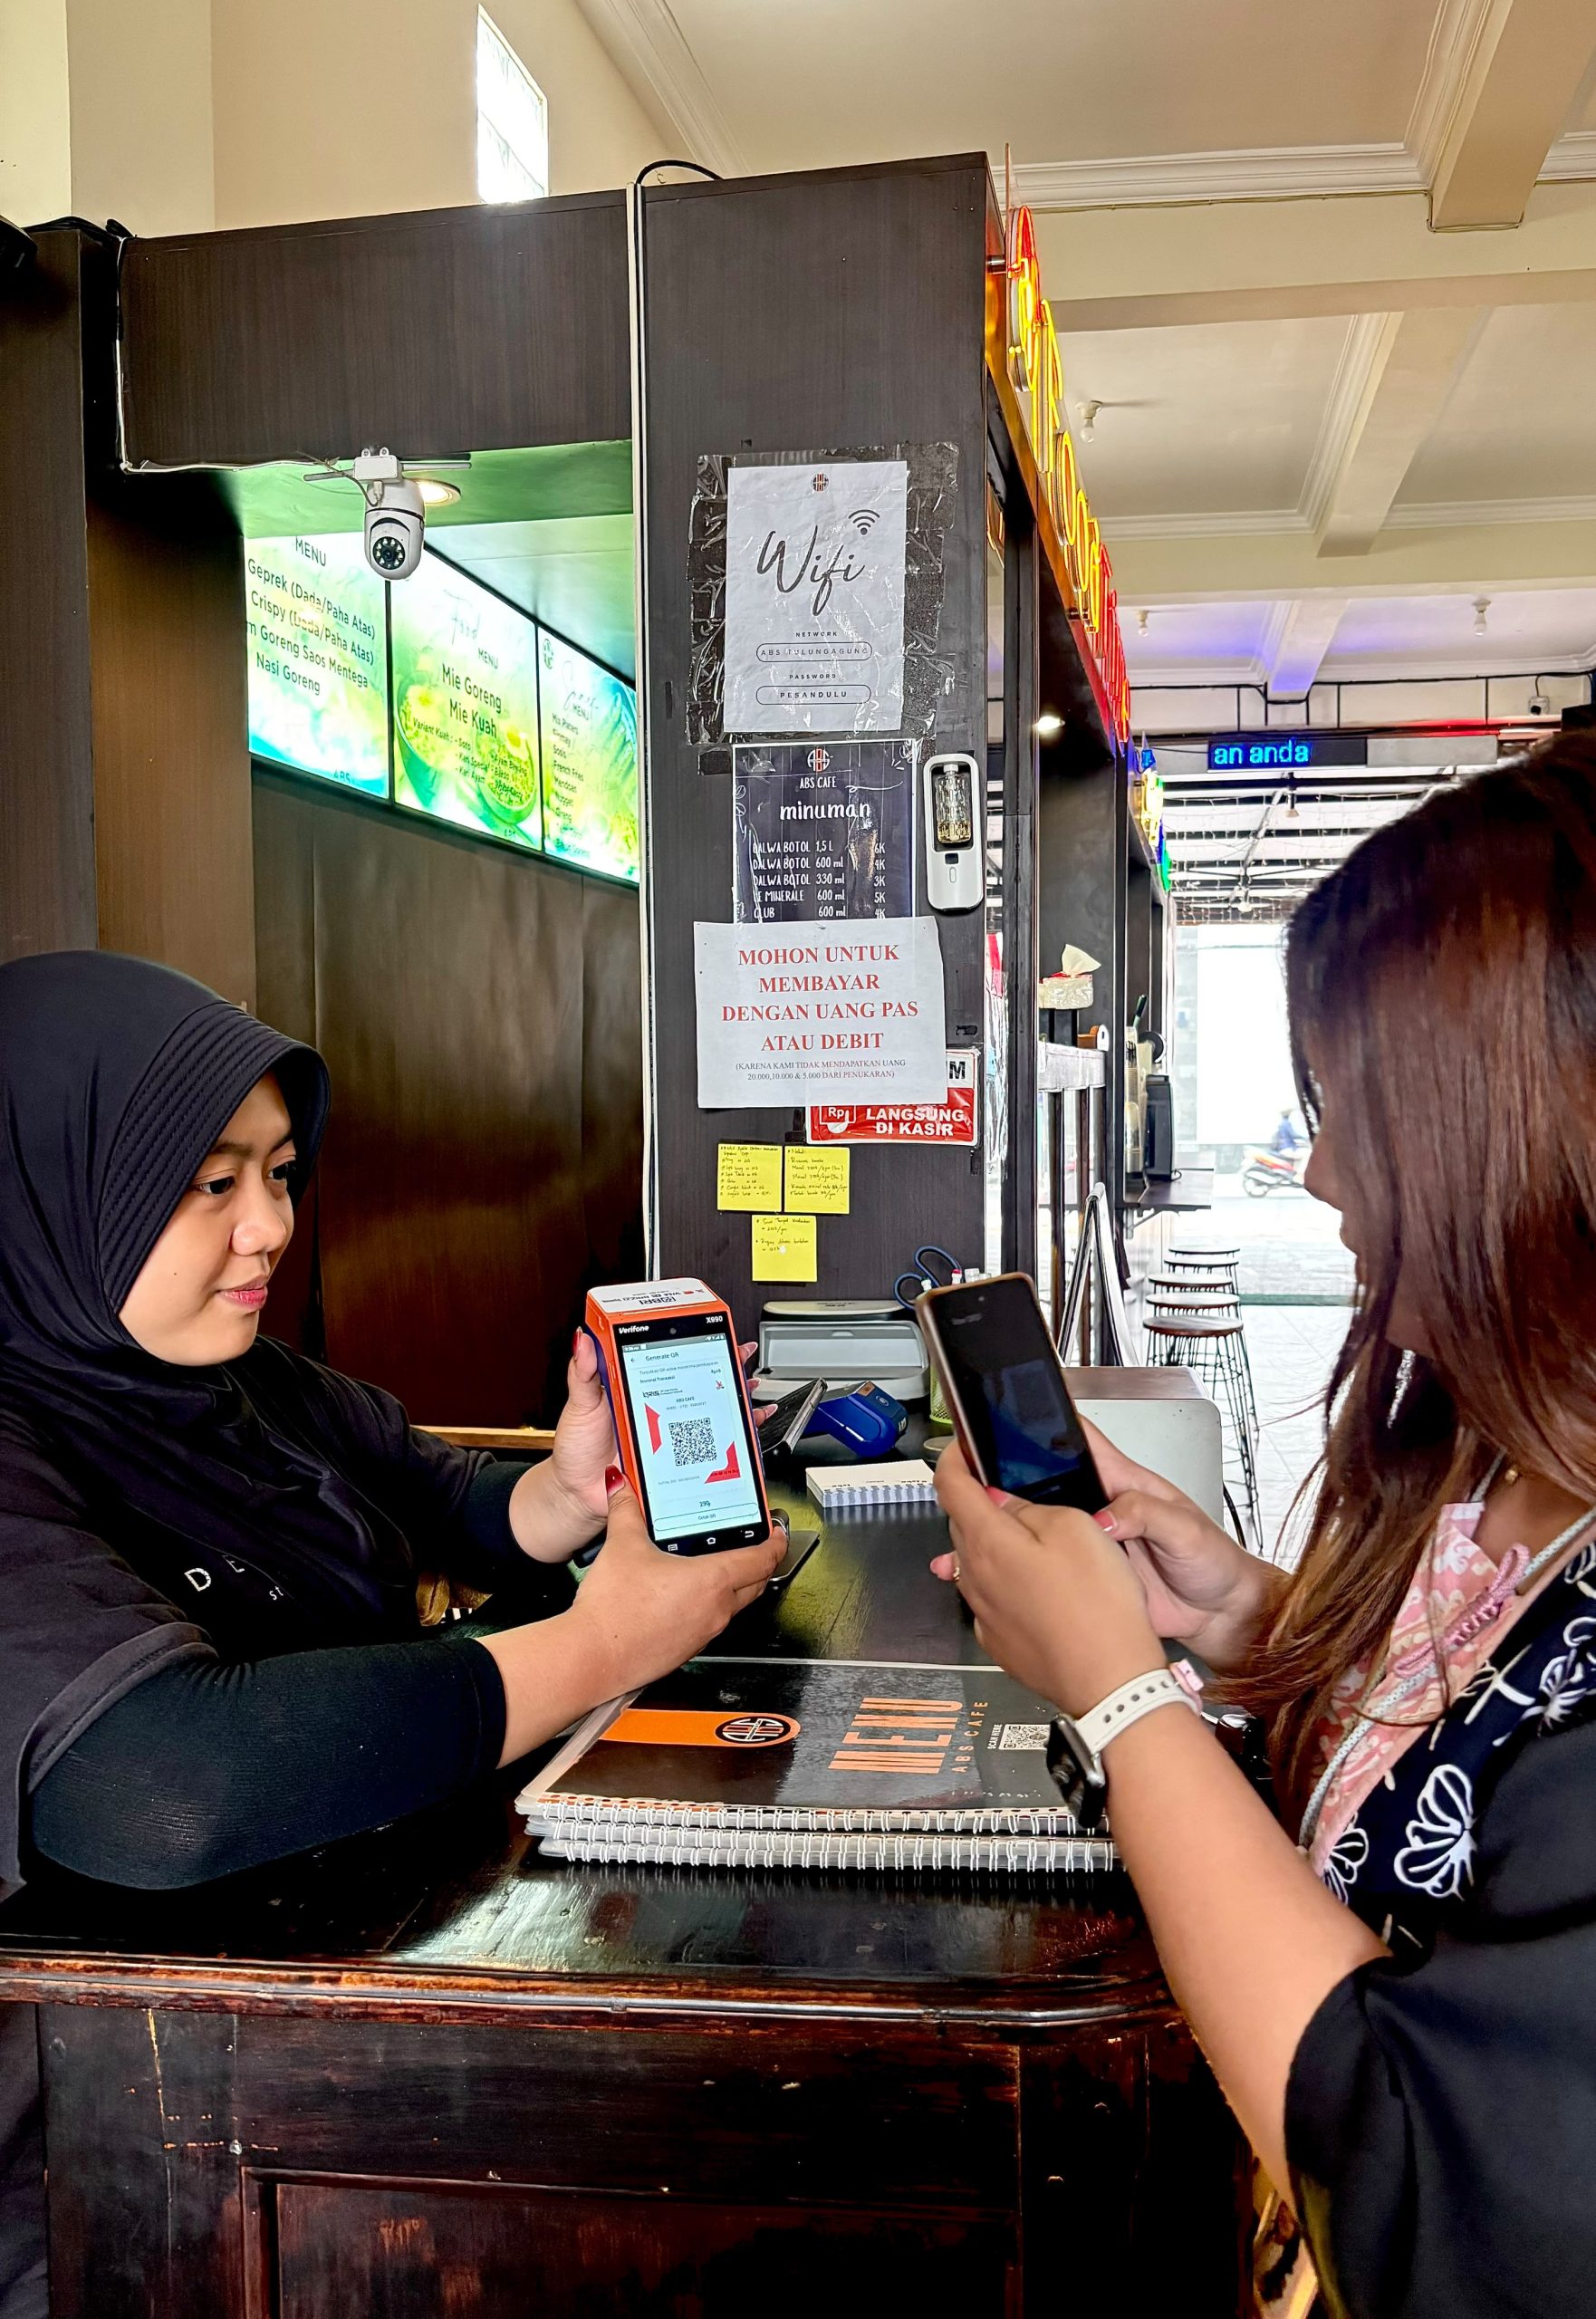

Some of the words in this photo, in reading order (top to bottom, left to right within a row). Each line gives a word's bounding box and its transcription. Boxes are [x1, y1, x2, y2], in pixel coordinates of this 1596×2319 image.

[295, 536, 326, 567] MENU
[757, 524, 866, 617] Wifi
[247, 558, 288, 592] Geprek
[352, 615, 376, 640] Atas)
[251, 591, 286, 622] Crispy
[351, 643, 374, 666] Atas)
[260, 625, 300, 659] Goreng
[303, 645, 326, 669] Saos
[329, 657, 369, 688] Mentega
[478, 647, 499, 669] MENU
[256, 651, 280, 677] Nasi
[283, 665, 321, 696] Goreng
[442, 663, 462, 690] Mie
[465, 677, 502, 715] Goreng
[413, 717, 435, 735] Variant
[449, 698, 468, 724] Mie
[472, 710, 497, 739] Kuah
[1215, 746, 1243, 765] an
[1250, 739, 1309, 764] anda
[800, 776, 814, 789] ABS
[817, 776, 837, 788] CAFE
[780, 800, 870, 821] minuman
[753, 842, 782, 853] DALWA
[783, 841, 811, 853] BOTOL
[816, 840, 827, 853] 1,5
[828, 840, 833, 852] L
[875, 842, 885, 854] 6K
[753, 858, 782, 870] DALWA
[783, 857, 811, 870] BOTOL
[816, 856, 831, 869] 600
[832, 856, 843, 869] ml
[875, 858, 885, 871] 4K
[754, 874, 782, 886] DALWA
[783, 873, 811, 886] BOTOL
[816, 873, 832, 885] 330
[834, 872, 845, 885] ml
[874, 875, 885, 887] 3K
[764, 890, 804, 902] MINERALE
[817, 890, 832, 901] 600
[834, 890, 845, 901] ml
[874, 891, 885, 903] 5K
[818, 906, 833, 917] 600
[835, 906, 846, 917] ml
[875, 908, 886, 919] 4K
[738, 948, 819, 966] MOHON
[825, 944, 899, 963] UNTUK
[759, 974, 880, 993] MEMBAYAR
[722, 1005, 809, 1022] DENGAN
[816, 1002, 875, 1019] UANG
[881, 1001, 918, 1017] PAS
[761, 1034, 814, 1052] ATAU
[821, 1033, 884, 1050] DEBIT
[736, 1063, 772, 1071] (KARENA
[773, 1062, 794, 1070] KAMI
[795, 1061, 820, 1069] TIDAK
[821, 1060, 881, 1069] MENDAPATKAN
[882, 1059, 906, 1067] UANG
[747, 1072, 793, 1081] 20.000,10.000
[803, 1072, 821, 1080] 5.000
[822, 1071, 841, 1080] DARI
[842, 1070, 895, 1079] PENUKARAN)
[829, 1108, 844, 1119] Rp
[866, 1108, 965, 1121] LANGSUNG
[876, 1122, 893, 1134] DI
[899, 1123, 954, 1136] KASIR
[706, 1315, 723, 1324] X990
[619, 1325, 649, 1334] Verifone
[646, 1352, 669, 1362] Generate
[828, 1697, 964, 1774] MENU
[952, 1745, 975, 1773] ABS
[965, 1701, 988, 1737] CAFE
[991, 1724, 1002, 1736] HERE
[987, 1736, 998, 1749] SCAN
